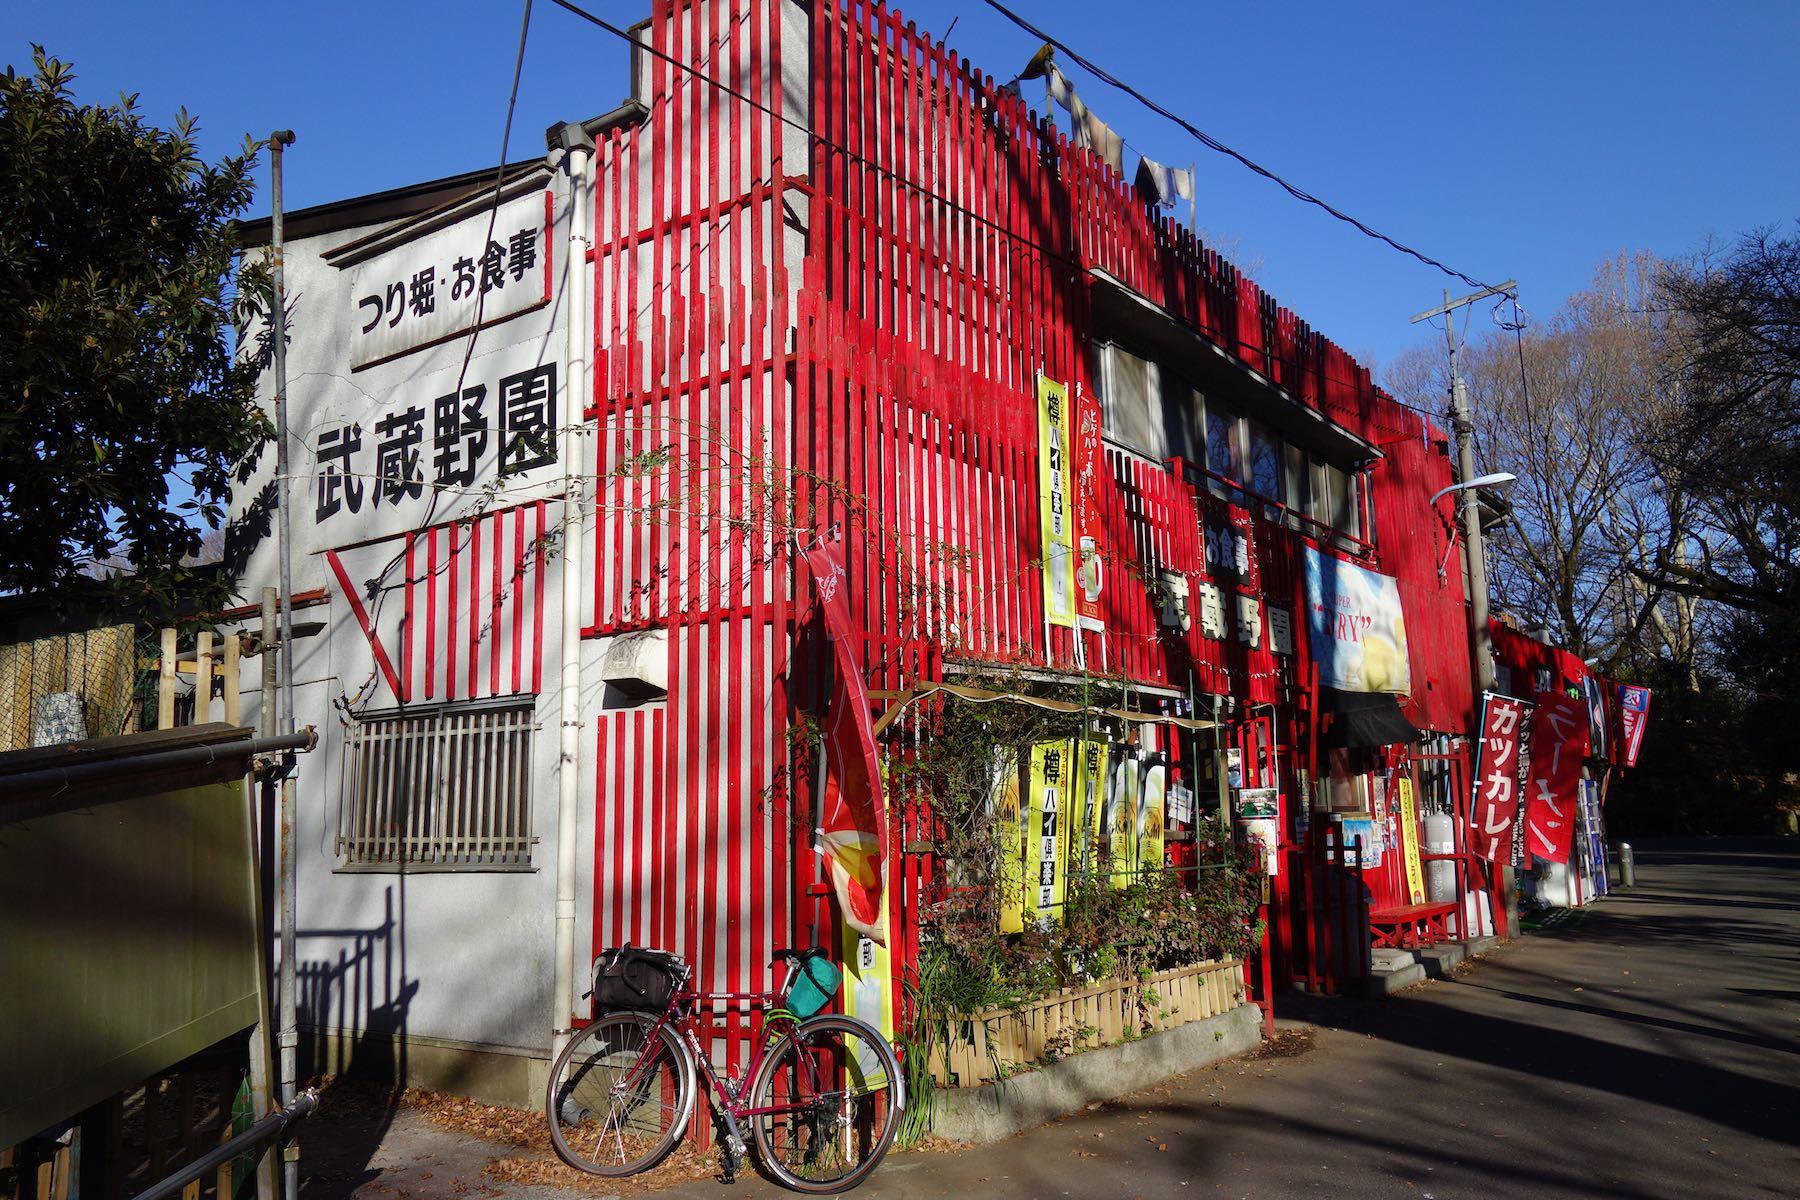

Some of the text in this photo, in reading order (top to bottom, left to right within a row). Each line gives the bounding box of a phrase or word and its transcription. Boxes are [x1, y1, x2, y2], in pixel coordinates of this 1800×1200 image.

[358, 227, 537, 335] つり堀・お食事
[316, 361, 557, 525] 武蔵野園
[1206, 525, 1249, 576] お食事
[1161, 570, 1292, 655] 武蔵野園
[1485, 704, 1518, 860] カツカレー
